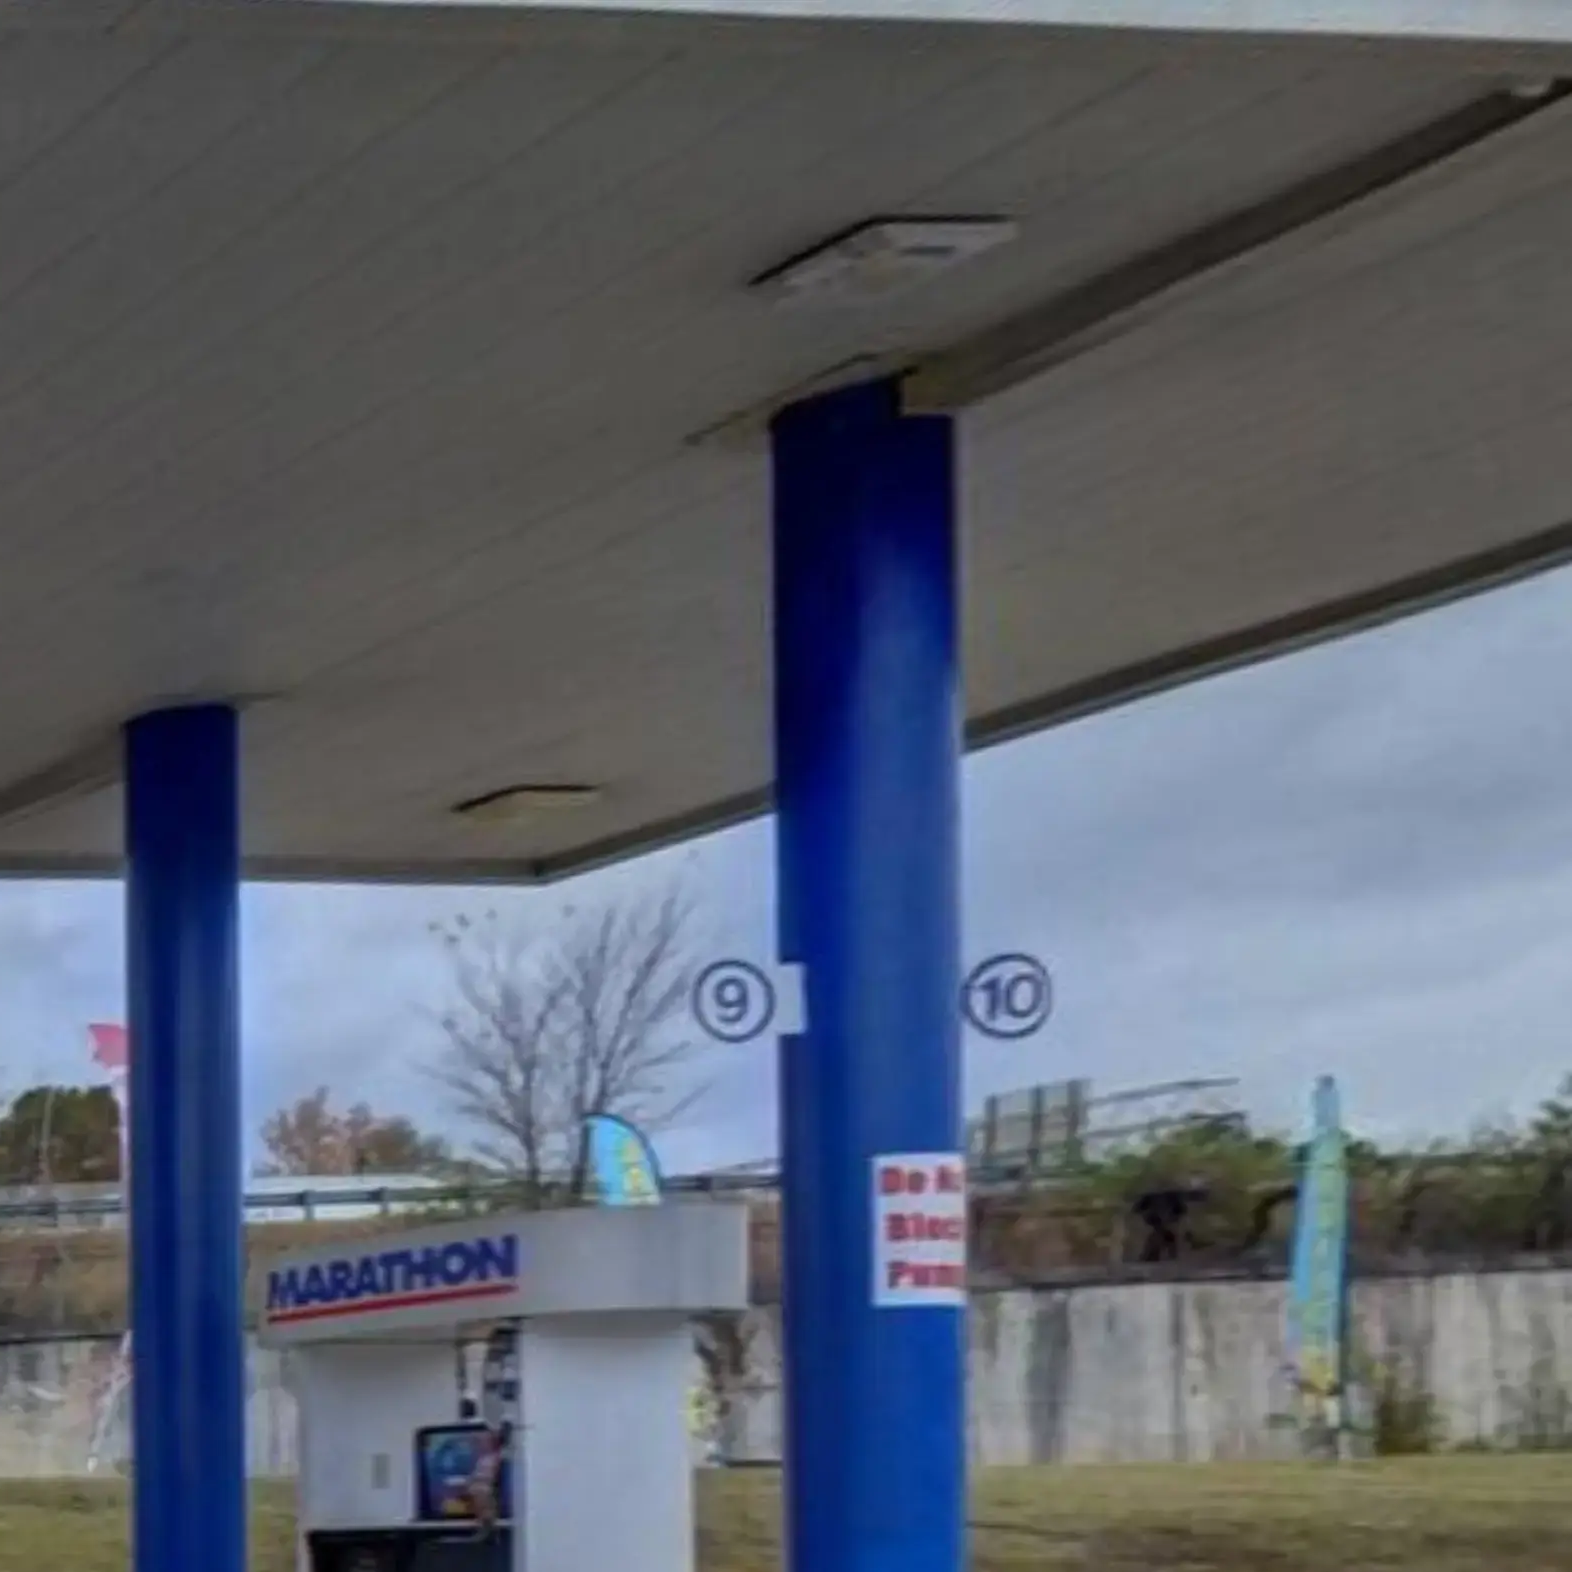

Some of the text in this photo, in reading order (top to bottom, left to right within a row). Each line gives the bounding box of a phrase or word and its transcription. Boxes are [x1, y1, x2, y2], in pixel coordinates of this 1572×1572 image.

[714, 977, 749, 1024] 9
[975, 973, 1042, 1020] 10
[886, 1212, 965, 1241] Bloc
[265, 1233, 519, 1311] MARATHON
